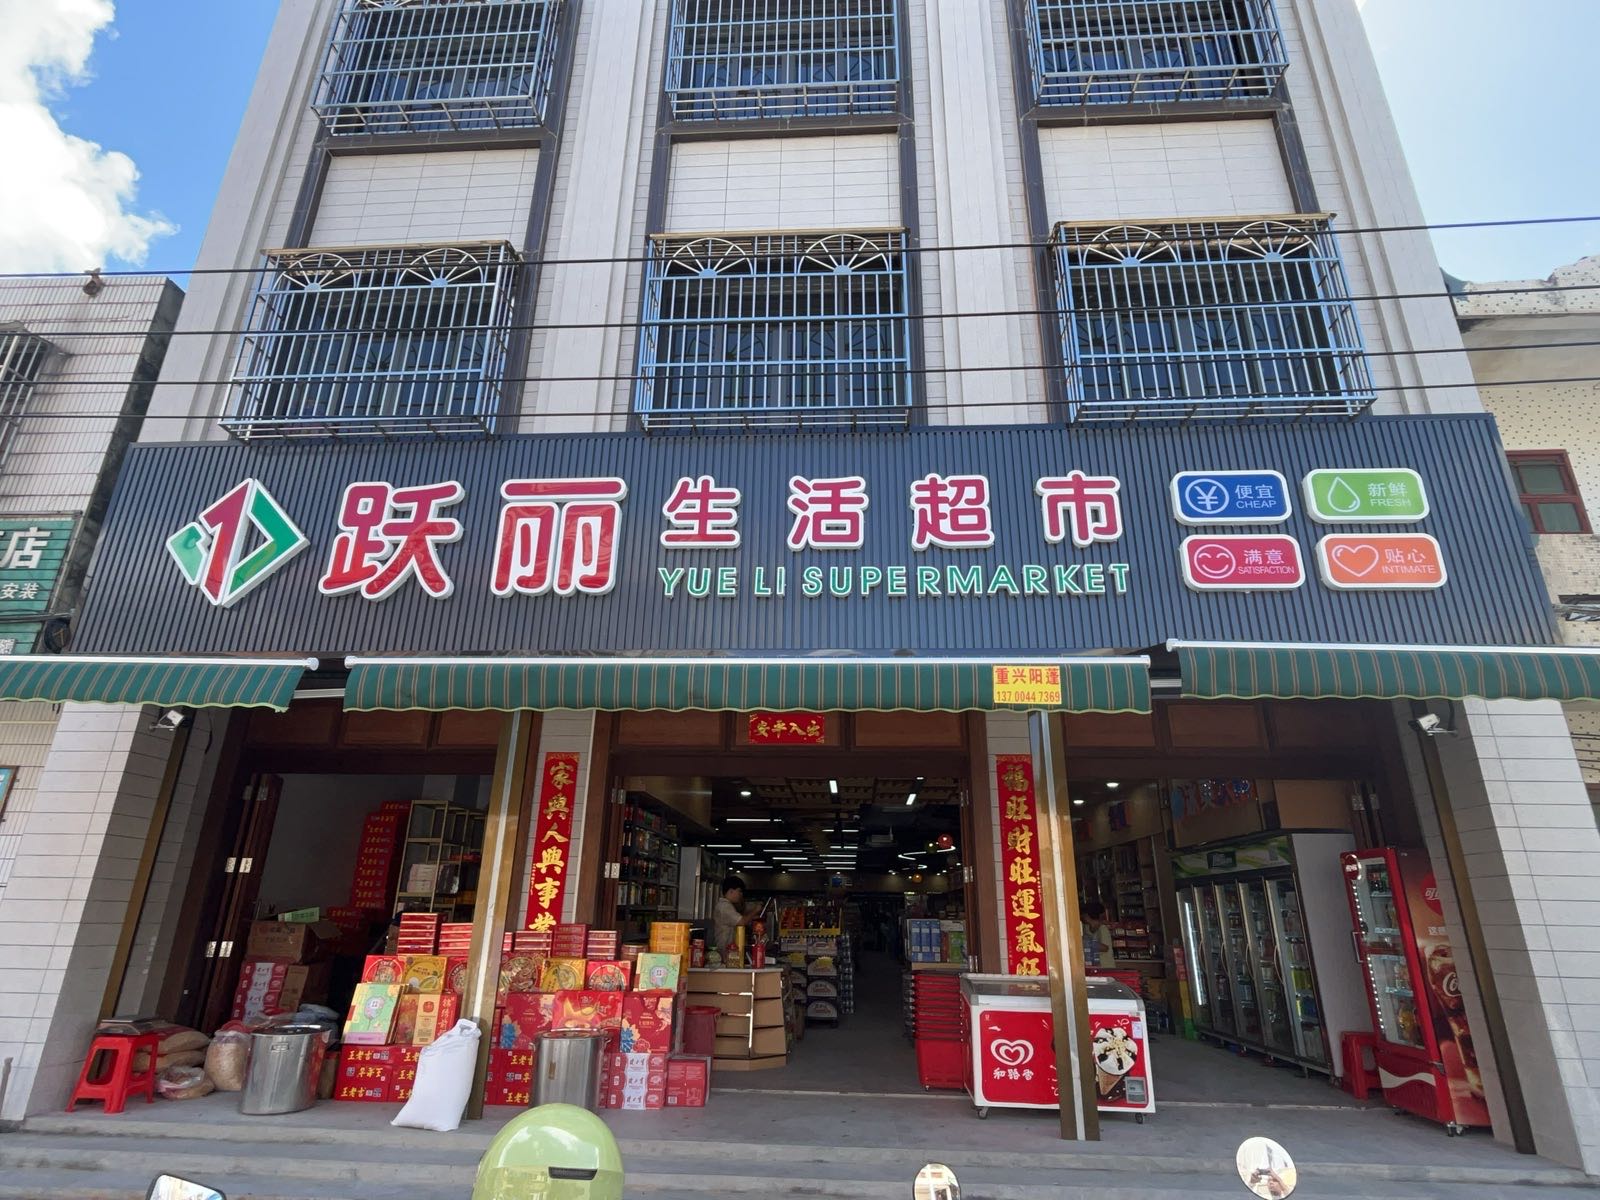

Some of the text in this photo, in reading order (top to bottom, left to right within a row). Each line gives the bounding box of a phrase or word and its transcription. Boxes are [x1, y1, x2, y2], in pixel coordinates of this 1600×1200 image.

[1235, 484, 1276, 500] 便宜
[1367, 482, 1409, 498] 新鲜
[1236, 500, 1277, 509] CHEAP
[1370, 498, 1412, 507] FRESH
[318, 472, 1123, 600] 跃丽生活超市
[0, 527, 52, 569] 店
[1384, 548, 1427, 564] 贴心
[1243, 548, 1285, 566] 满意
[1237, 565, 1295, 575] SATISFACTION
[1381, 564, 1437, 575] INTIMATE
[659, 563, 1131, 598] YUE LI SUPERMARKET
[0, 582, 40, 600] 安装
[995, 667, 1060, 685] 重兴阳蓬
[997, 691, 1012, 702] 137
[1040, 691, 1061, 702] 7369
[993, 1067, 1034, 1081] 和路雪
